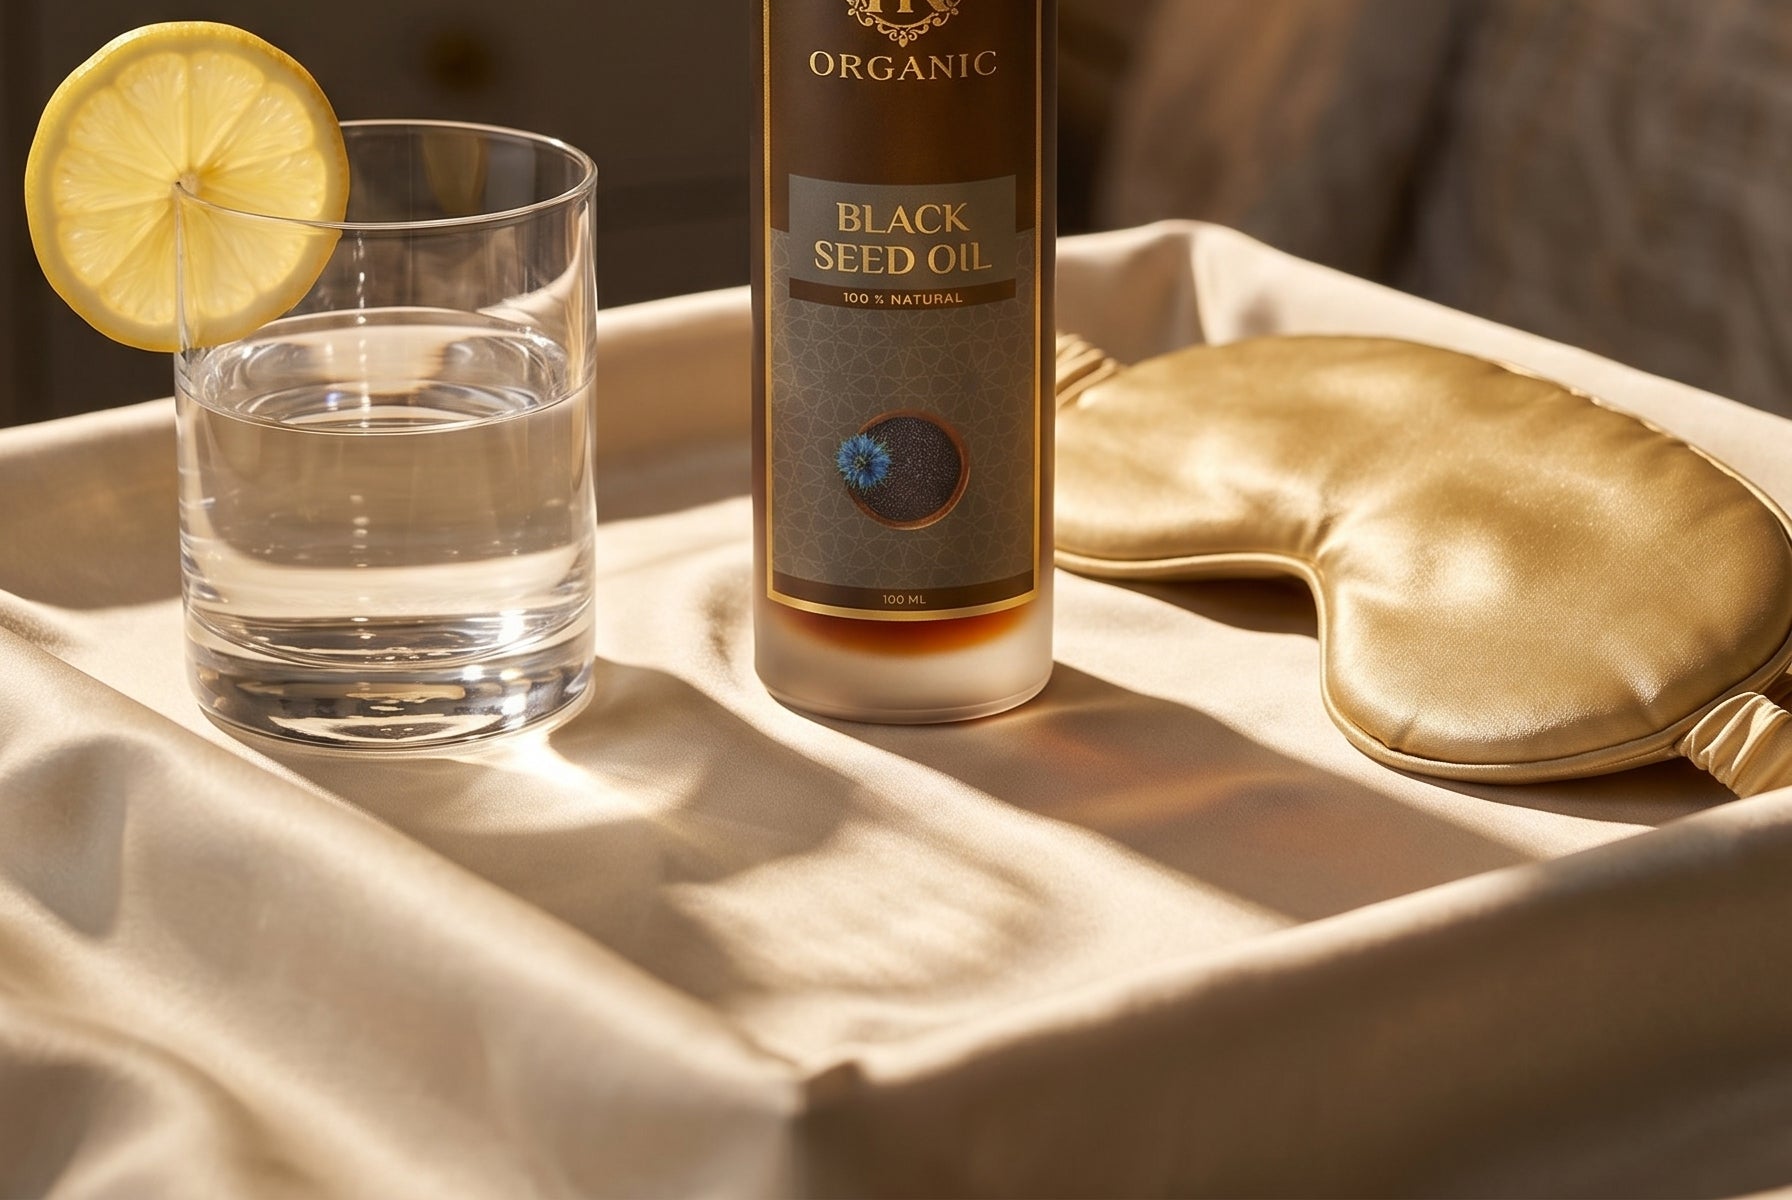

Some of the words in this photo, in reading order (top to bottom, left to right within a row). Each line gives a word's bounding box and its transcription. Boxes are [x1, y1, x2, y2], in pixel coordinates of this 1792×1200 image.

[808, 50, 997, 81] ORGANIC
[836, 202, 970, 234] BLACK
[814, 240, 916, 275] SEED
[927, 241, 993, 275] OIL
[843, 292, 869, 304] 100
[874, 294, 884, 304] %
[890, 292, 963, 305] NATURAL
[882, 594, 905, 605] 100
[908, 594, 927, 605] ML
